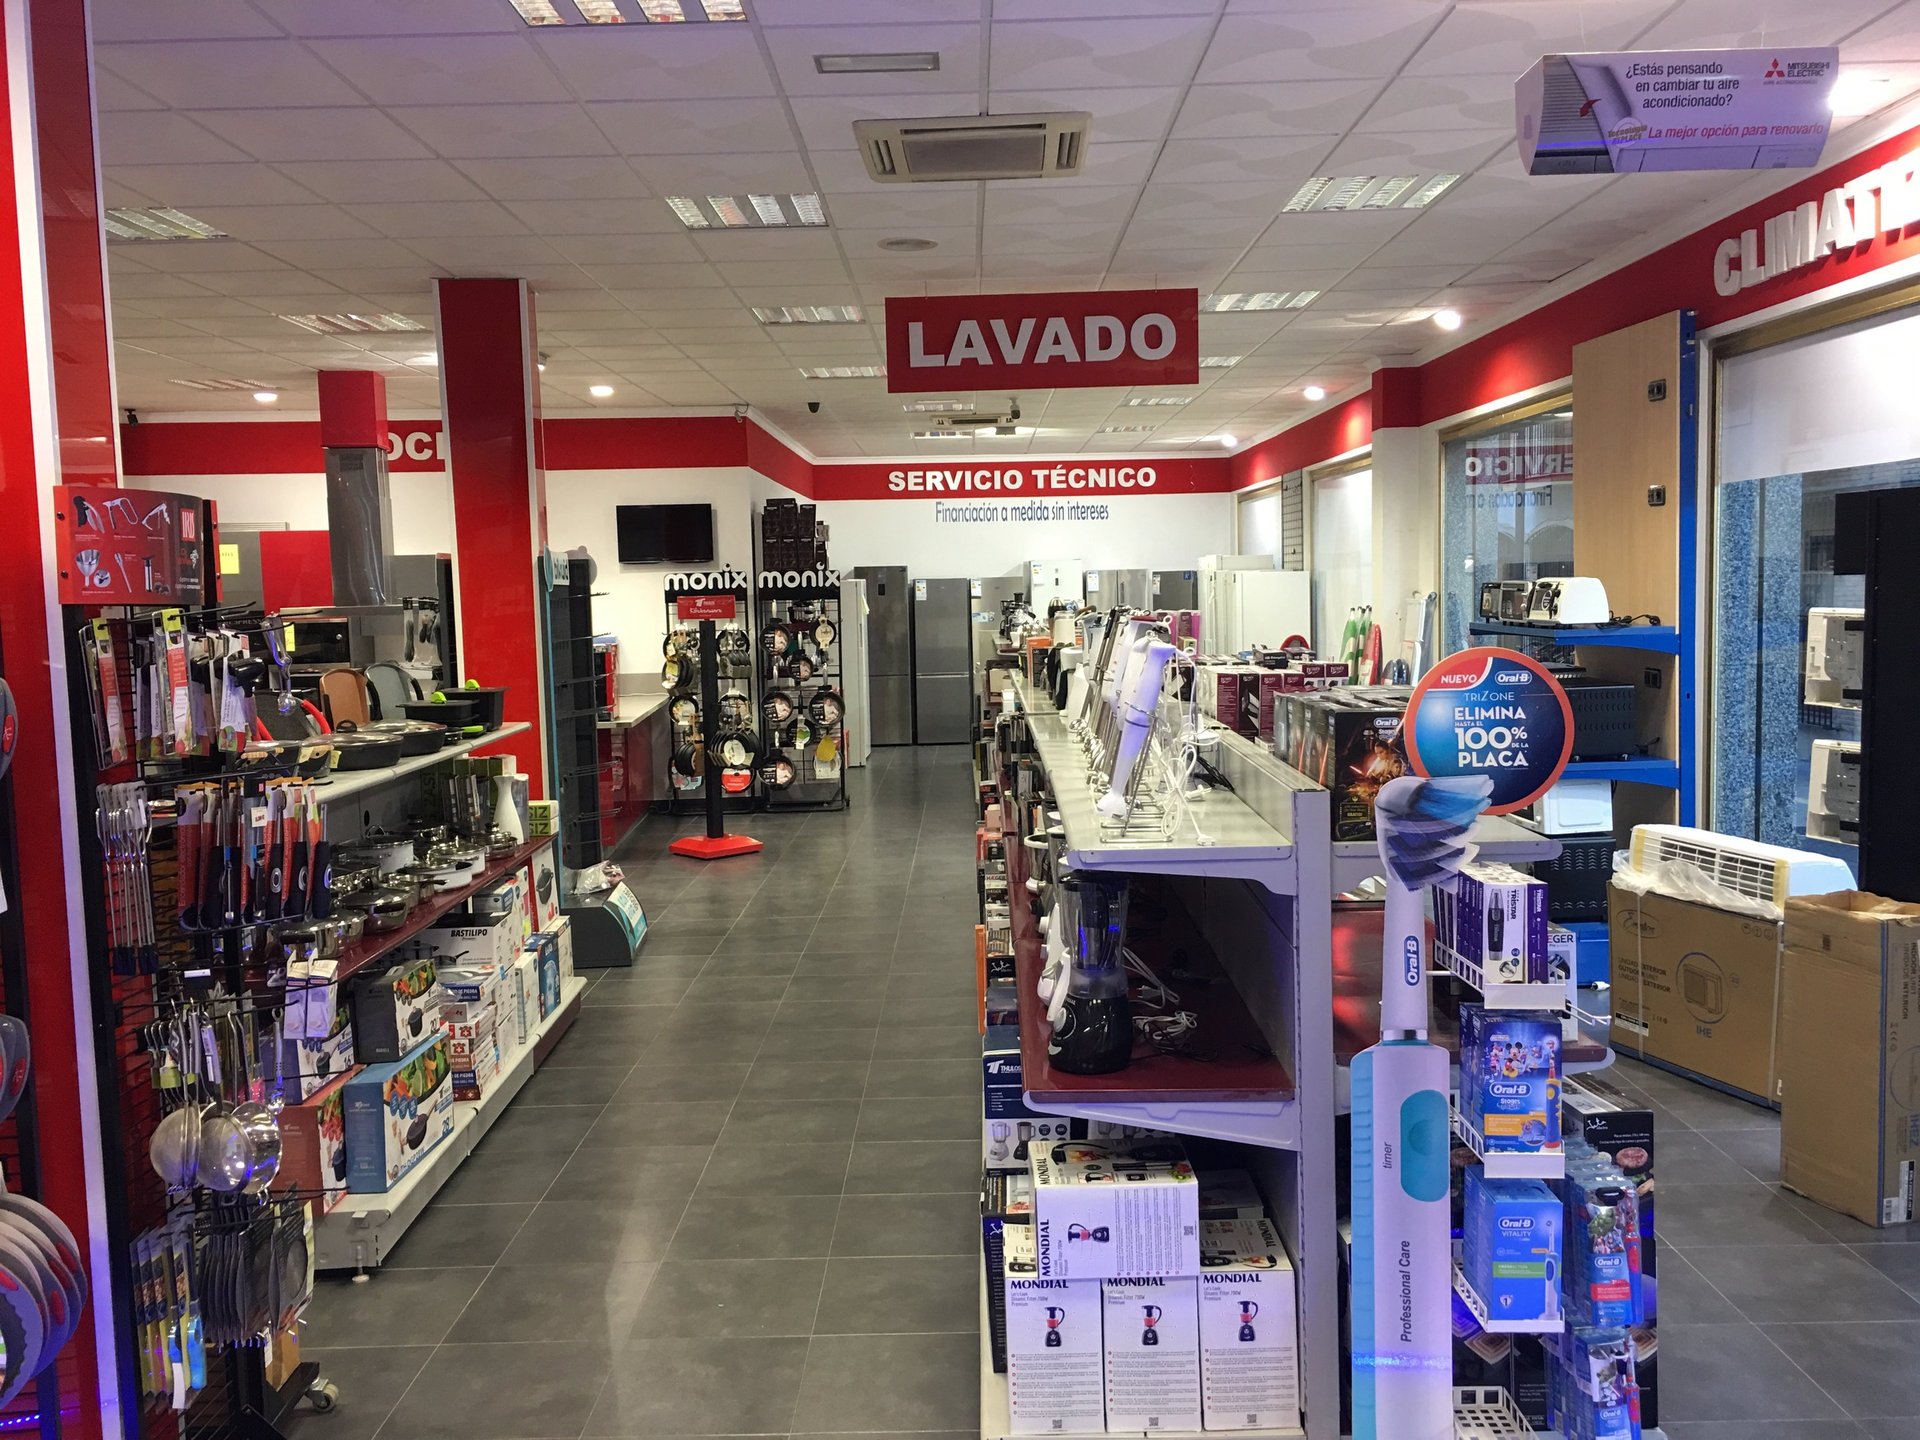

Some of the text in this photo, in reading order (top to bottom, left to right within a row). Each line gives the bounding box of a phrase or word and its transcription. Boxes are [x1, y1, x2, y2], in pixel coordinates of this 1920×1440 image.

[1626, 62, 1723, 79] ¿Estás pensando
[1787, 62, 1830, 70] MITSUBISHI
[1635, 78, 1740, 91] en cambiar tu aire
[1642, 93, 1733, 108] acondicionado?
[1648, 123, 1824, 140] La mejor opción para renovarlo
[908, 313, 1177, 368] LAVADO
[888, 464, 1157, 492] SERVICIO TÉCNICO
[935, 500, 1109, 523] Financiación a medida sin intereses
[664, 564, 747, 591] monix
[758, 561, 841, 589] monix
[1440, 674, 1478, 684] NUEVO
[1497, 673, 1529, 683] Oral-B
[1454, 705, 1527, 720] ELIMINA
[1375, 718, 1399, 727] Oral-B
[1454, 725, 1528, 750] 100%
[1458, 751, 1529, 768] PLACA
[450, 928, 488, 938] BASTILIPO
[1406, 938, 1418, 984] Oral-B
[1493, 1085, 1527, 1094] Oral-B
[1382, 1141, 1393, 1169] timer
[1035, 1157, 1050, 1185] MONDIAL
[1501, 1219, 1531, 1228] Oral-B
[1257, 1219, 1277, 1248] MONDIAL
[1040, 1218, 1051, 1277] MONDIAL
[1597, 1258, 1620, 1266] Oral-B
[1010, 1279, 1069, 1289] MONDIAL
[1107, 1277, 1166, 1287] MONDIAL
[1203, 1273, 1262, 1284] MONDIAL
[1399, 1240, 1411, 1343] Professional Care
